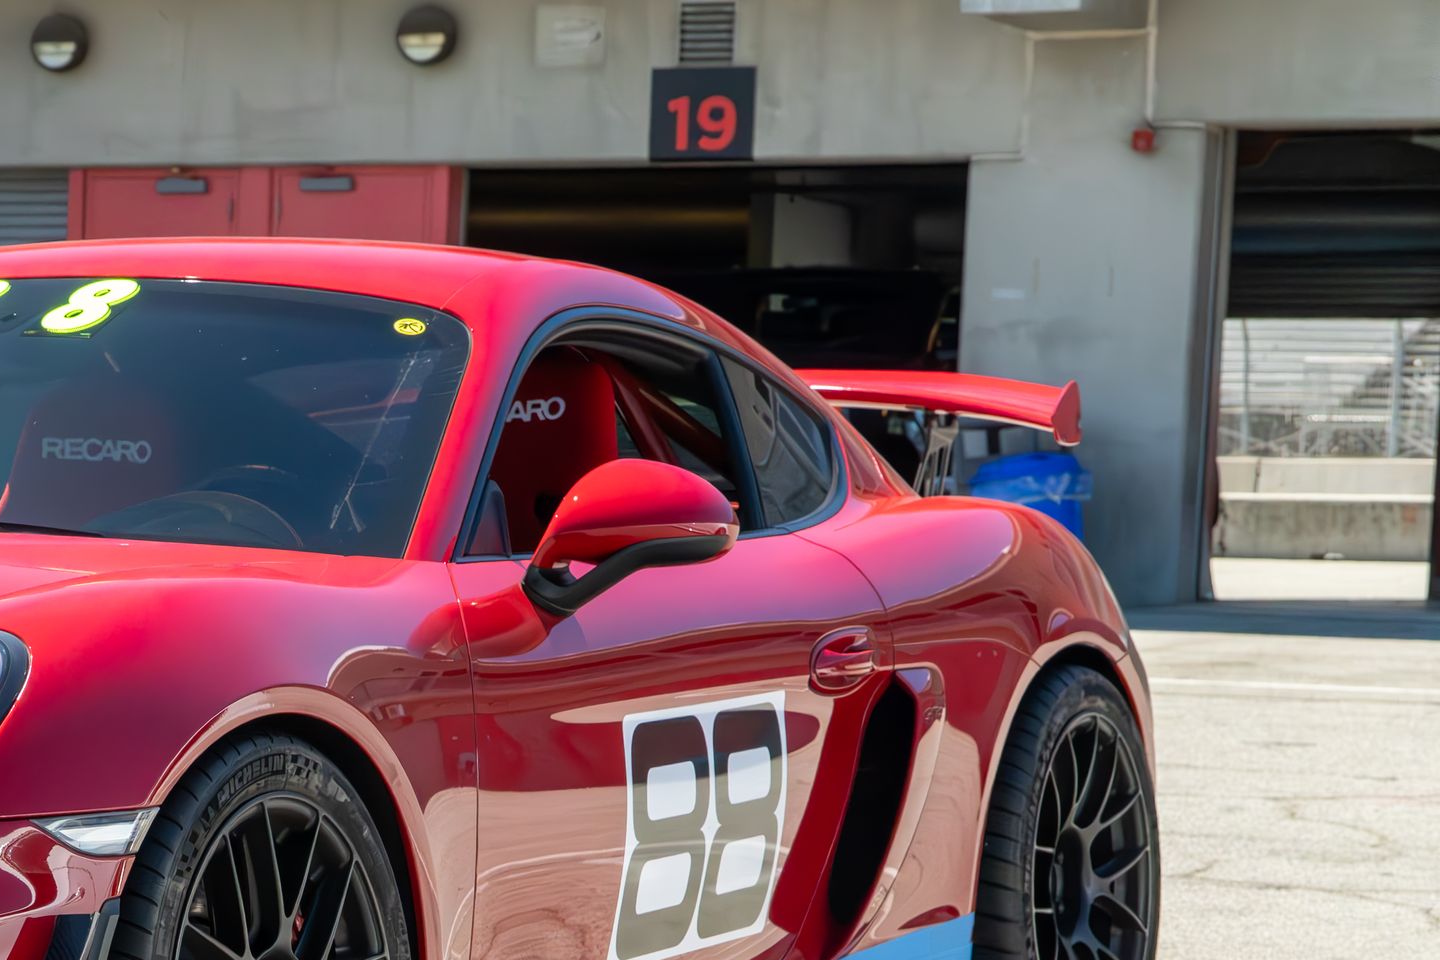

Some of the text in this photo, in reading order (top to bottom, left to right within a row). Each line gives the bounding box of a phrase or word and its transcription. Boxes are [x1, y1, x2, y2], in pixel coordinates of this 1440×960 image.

[667, 95, 737, 151] 19
[506, 396, 566, 423] ARO
[41, 437, 152, 464] RECARO
[216, 752, 286, 808] MICHELIN
[616, 702, 783, 960] 88
